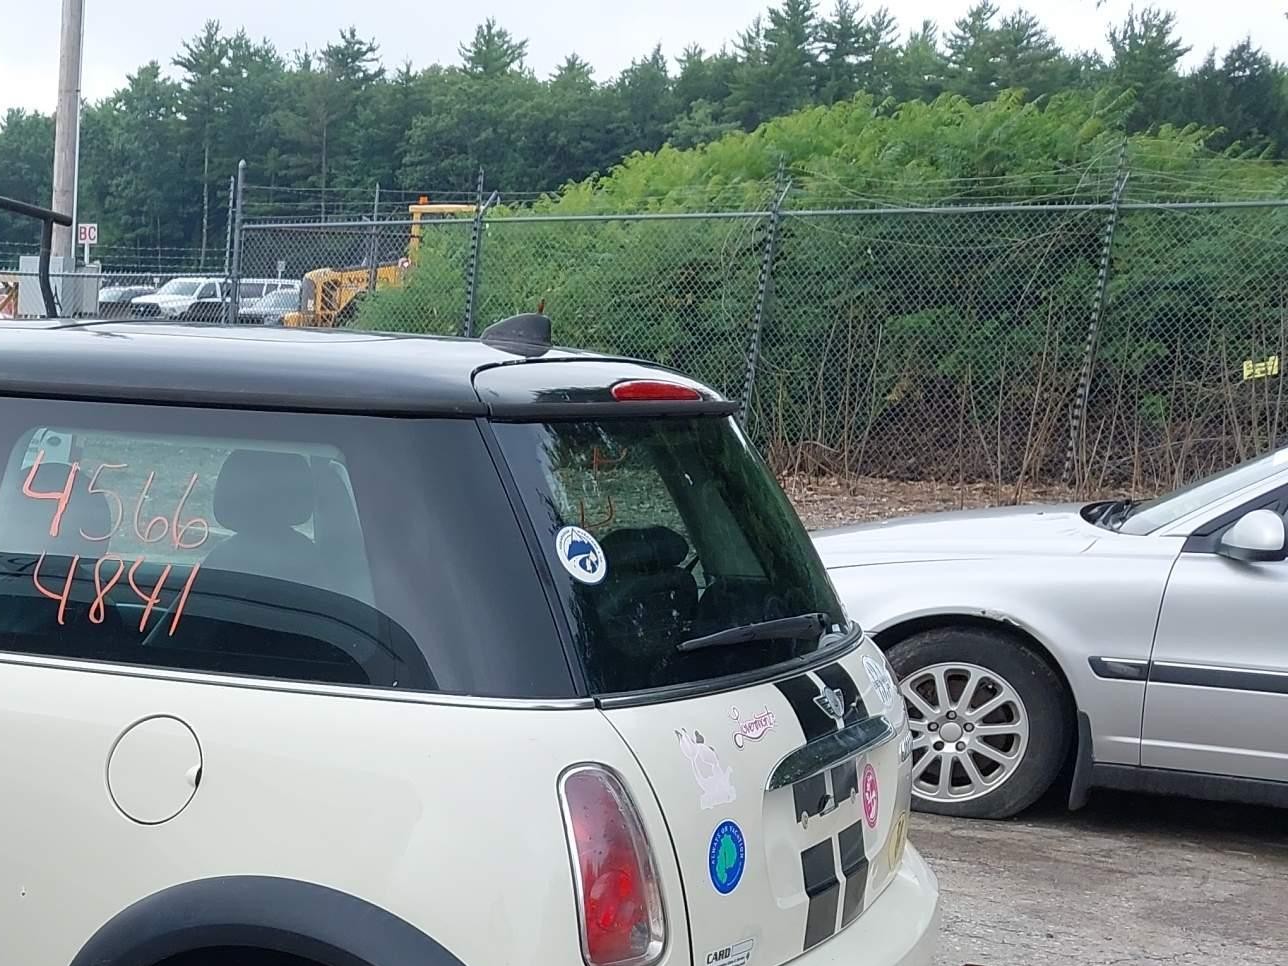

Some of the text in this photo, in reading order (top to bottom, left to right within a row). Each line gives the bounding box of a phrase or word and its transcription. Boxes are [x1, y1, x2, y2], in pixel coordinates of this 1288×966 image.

[79, 225, 97, 241] BC
[22, 448, 211, 550] 4566
[32, 550, 202, 637] 4841
[706, 947, 731, 965] CARD
